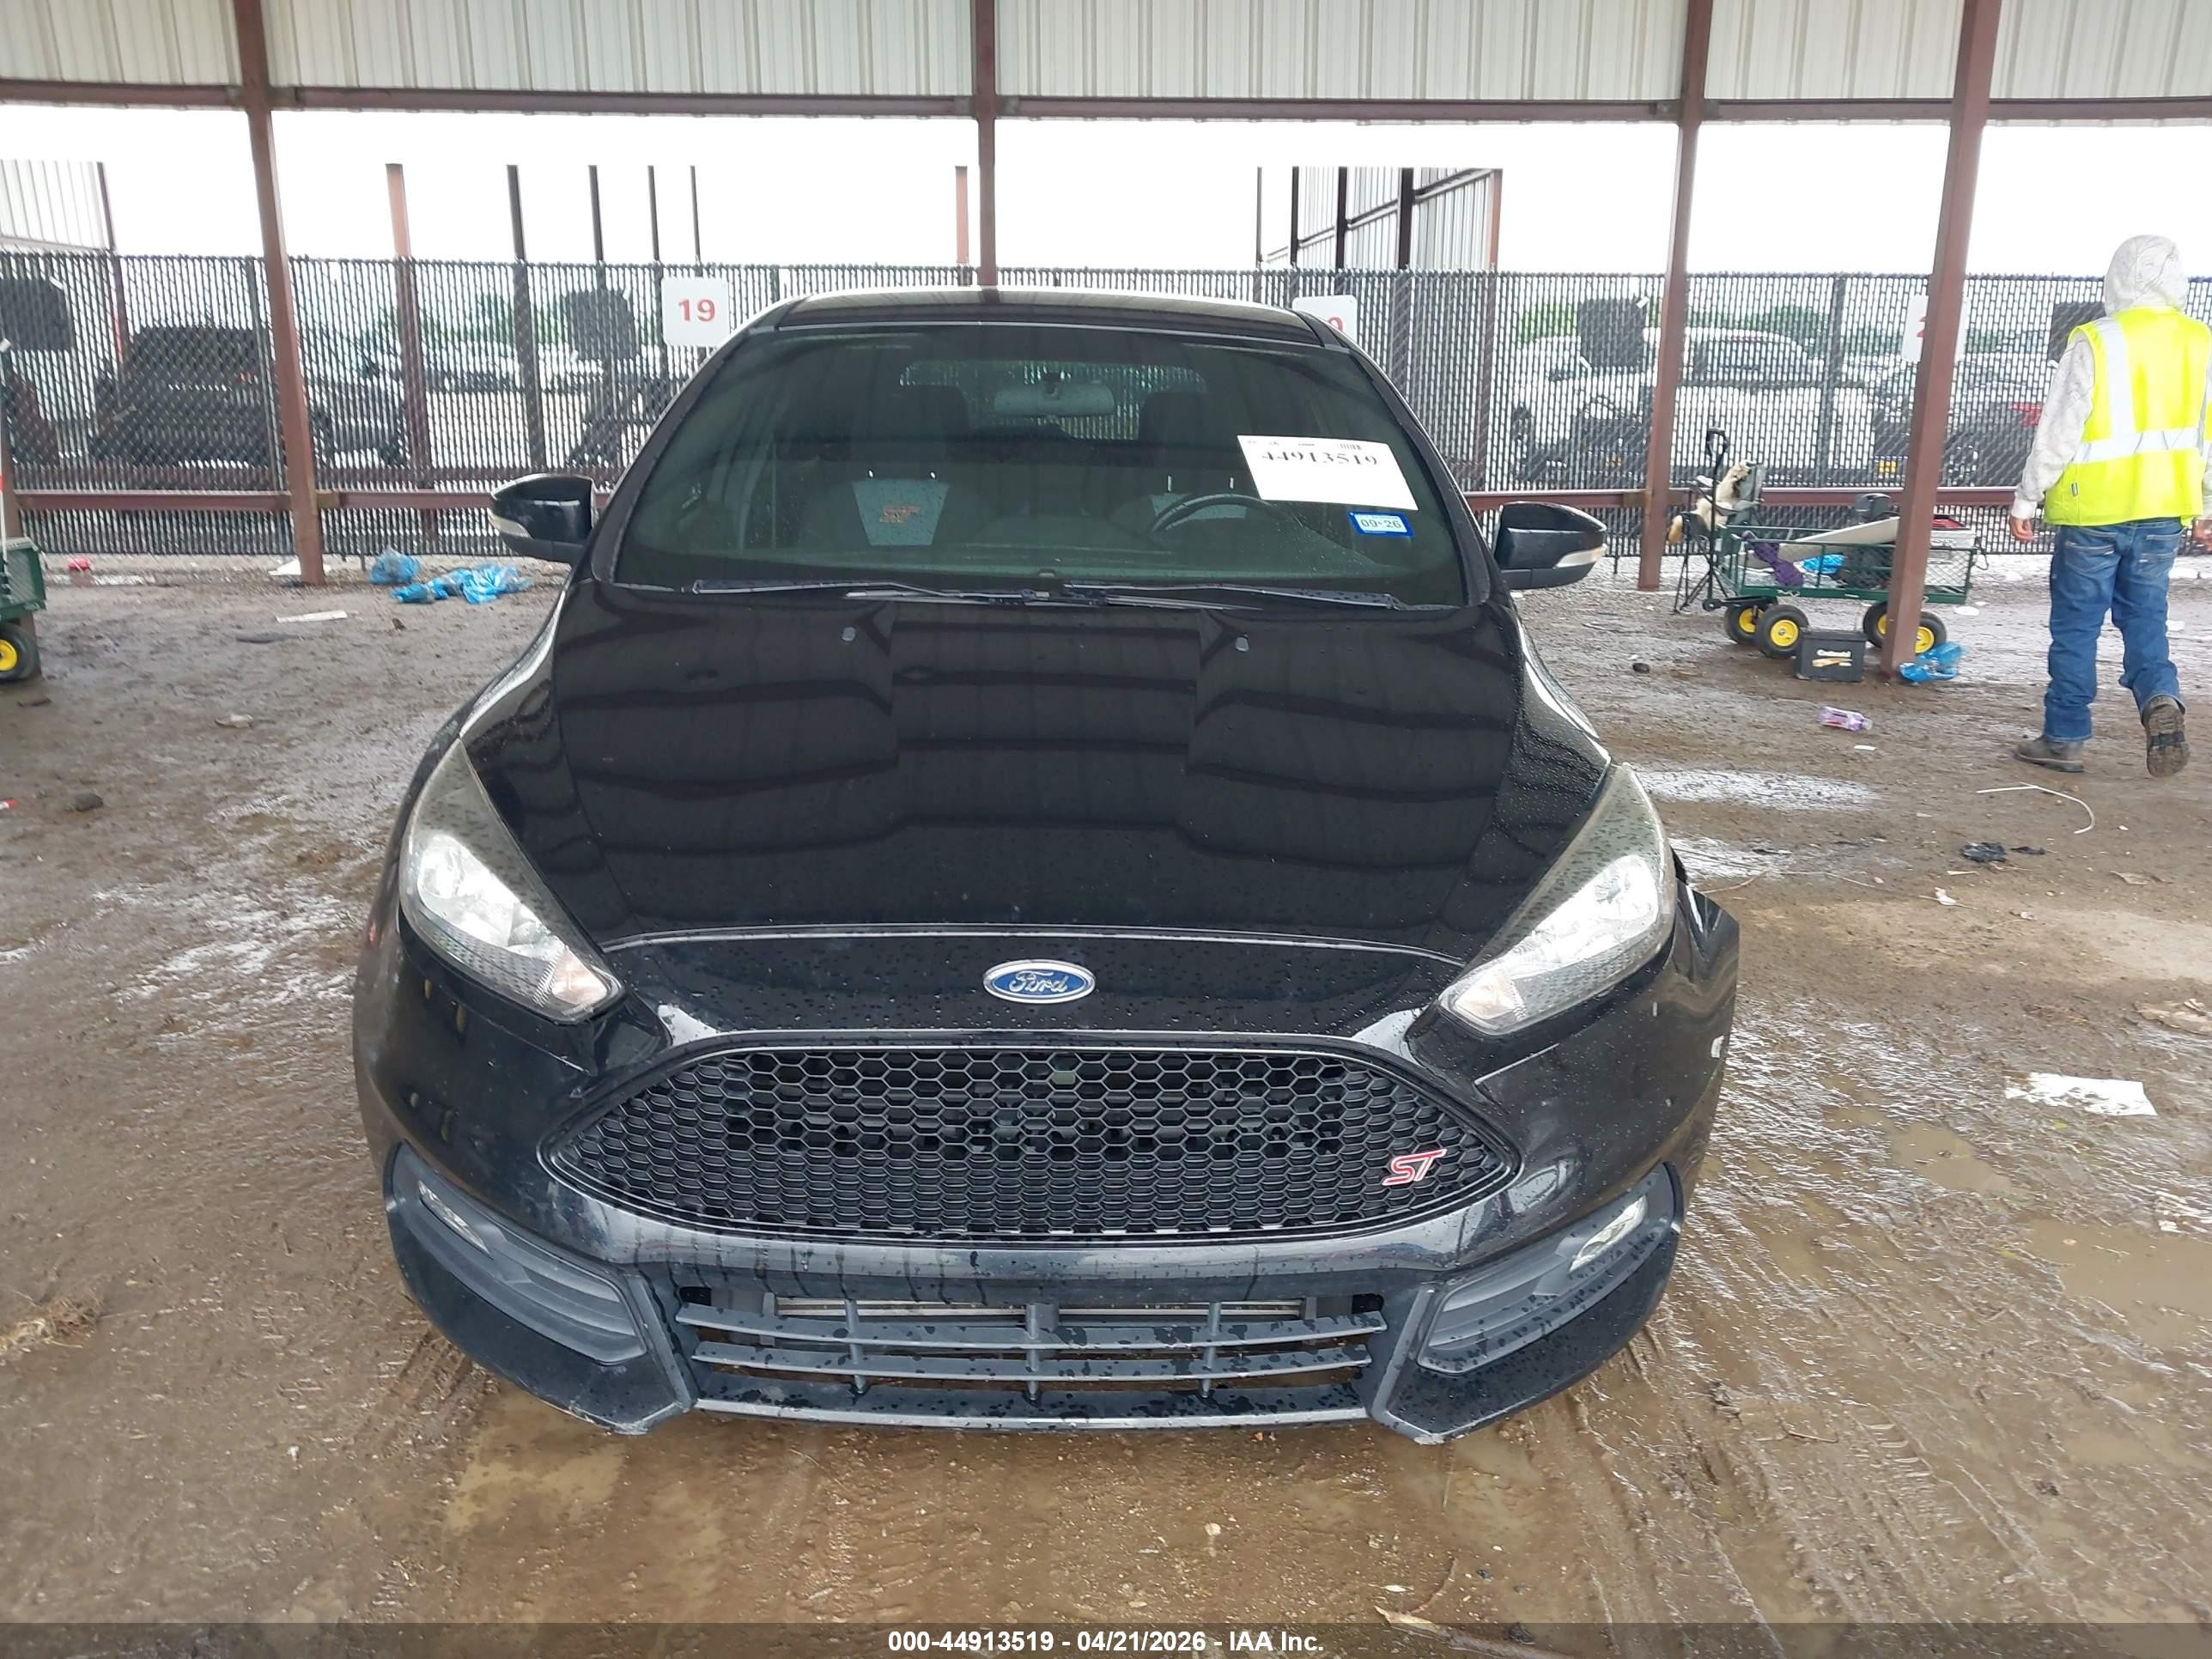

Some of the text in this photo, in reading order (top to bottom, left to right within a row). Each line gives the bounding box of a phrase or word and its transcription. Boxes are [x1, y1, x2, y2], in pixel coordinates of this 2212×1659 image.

[678, 298, 715, 323] 19
[1009, 970, 1068, 993] Ford
[1381, 1148, 1449, 1186] ST
